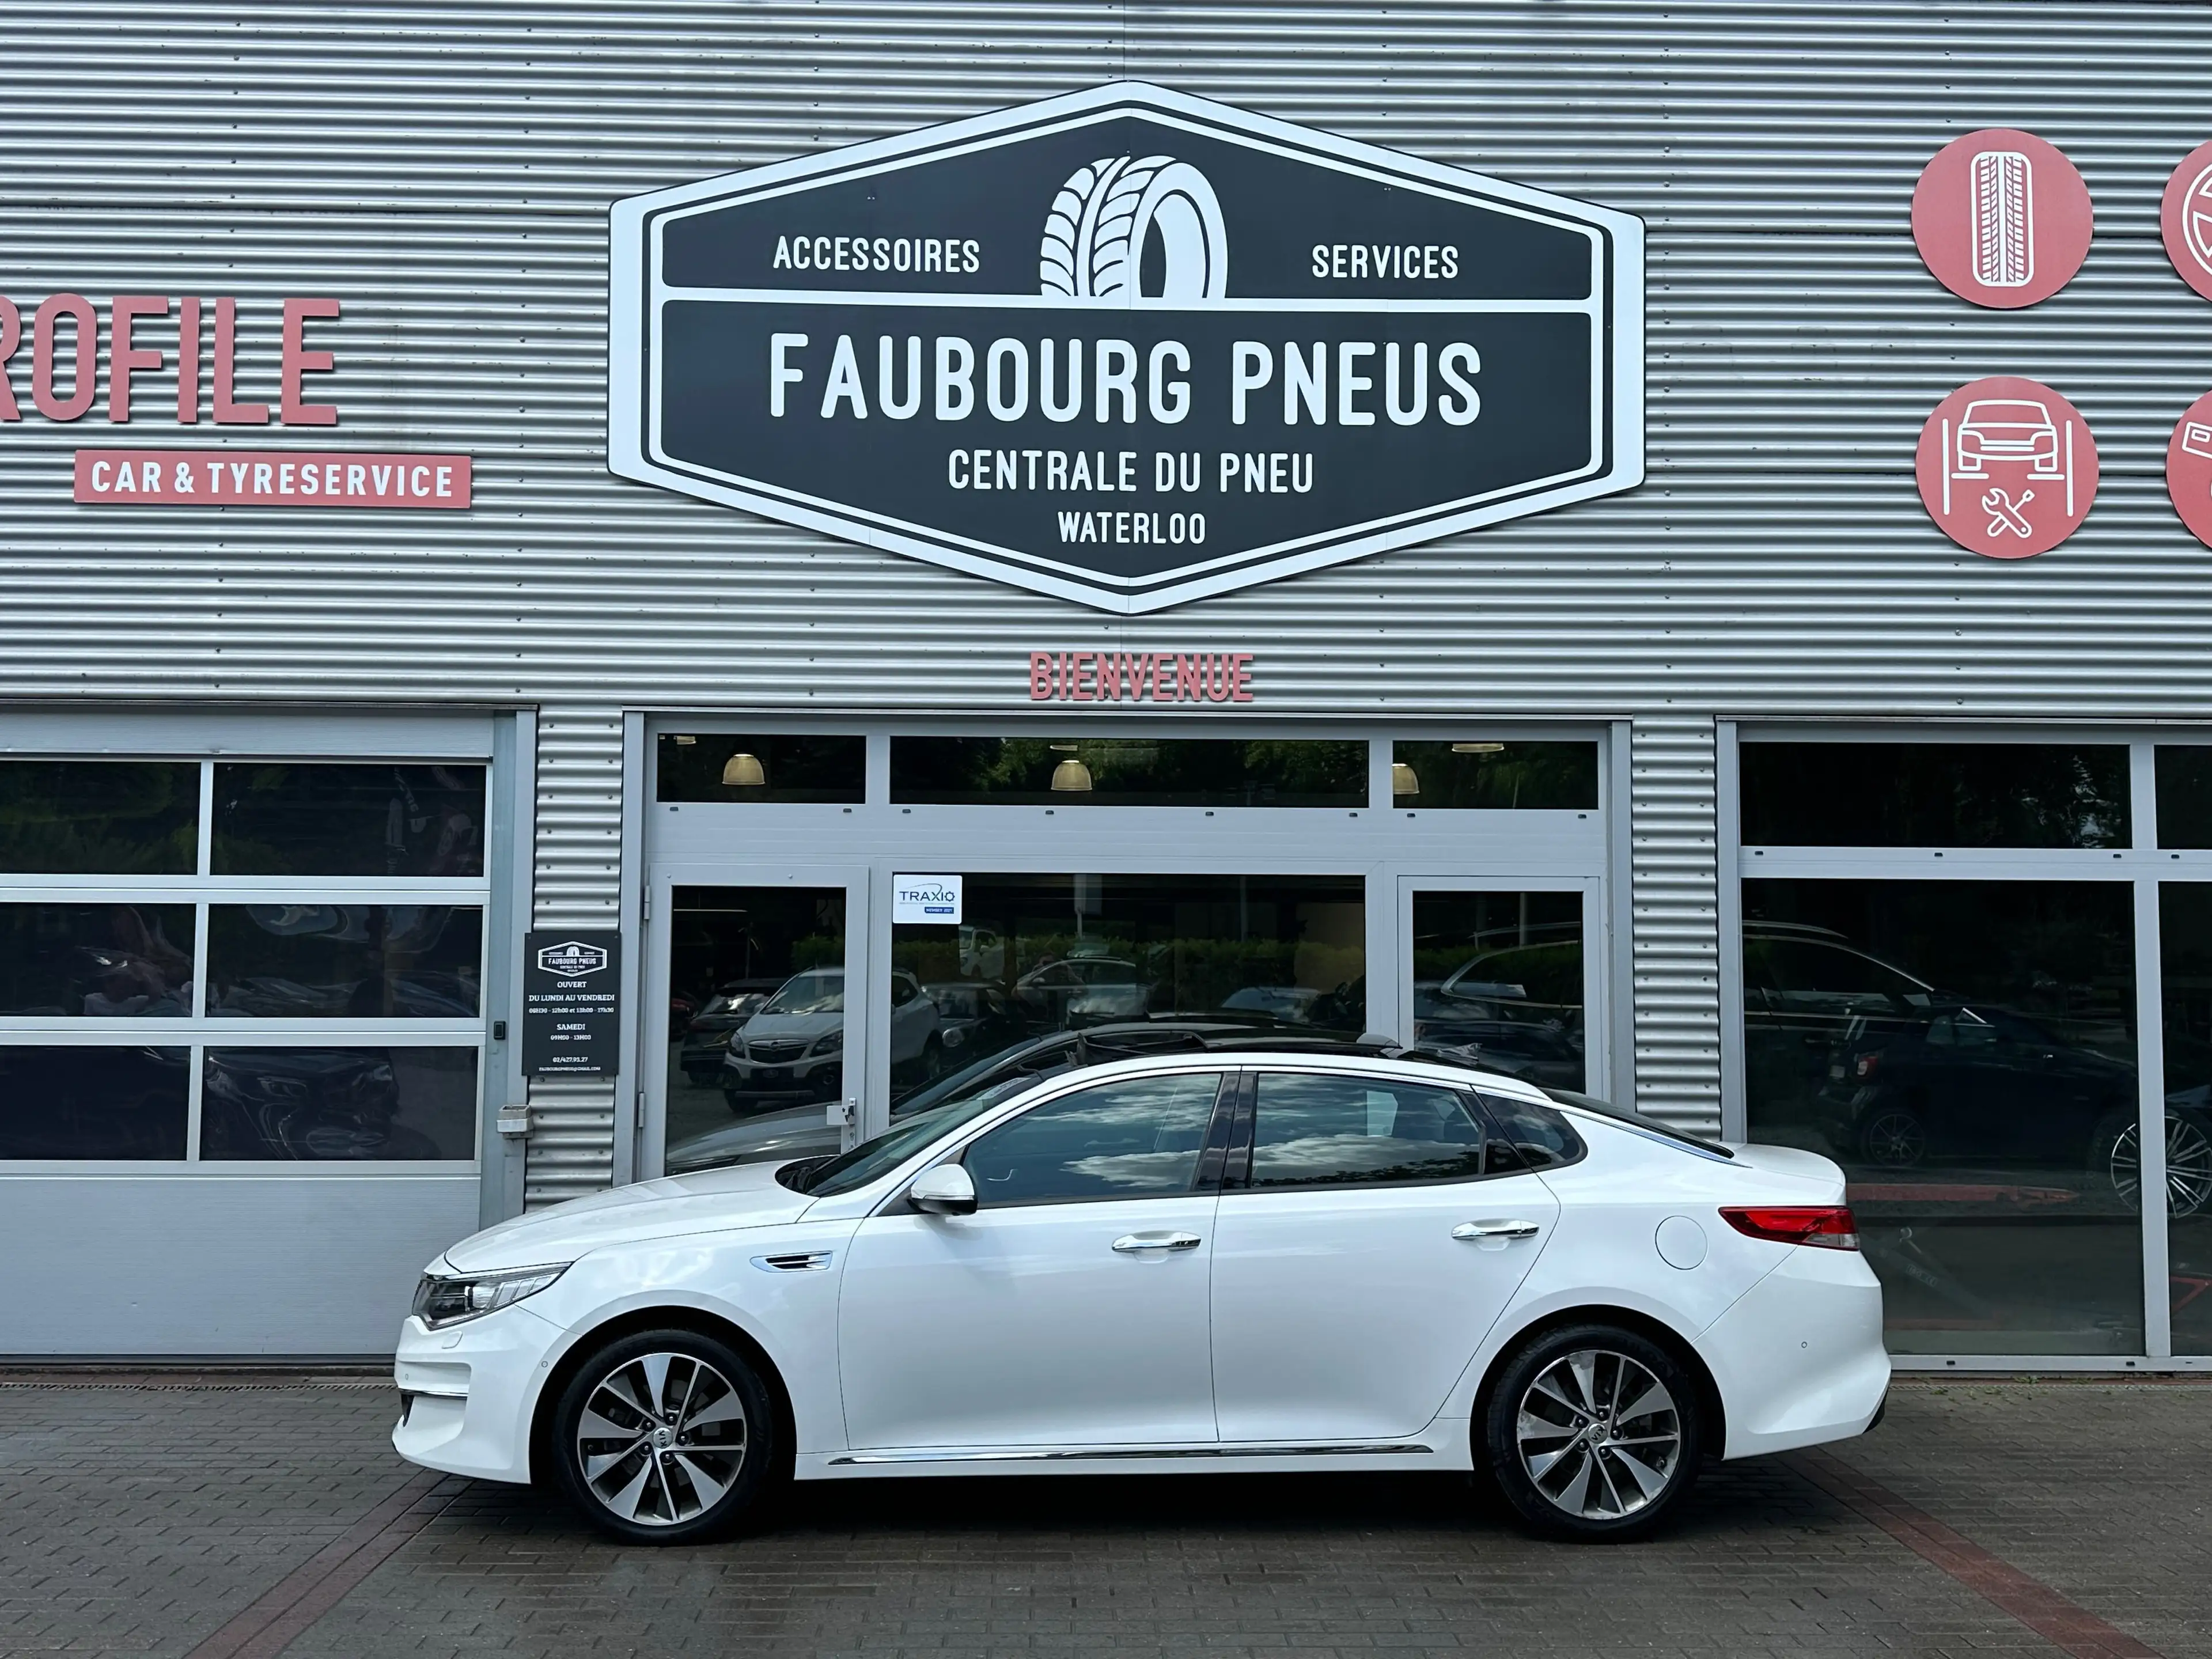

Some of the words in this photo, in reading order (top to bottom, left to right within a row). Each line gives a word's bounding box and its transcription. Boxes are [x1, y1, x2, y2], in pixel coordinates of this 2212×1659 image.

[773, 236, 979, 273] ACCESSOIRES
[1312, 245, 1459, 279] SERVICES
[770, 332, 1191, 425] FAUBOURG
[1232, 341, 1481, 426] PNEUS
[92, 461, 161, 493] CAR
[174, 462, 195, 493] &
[207, 463, 452, 497] TYRESERVICE
[948, 449, 1137, 491] CENTRALE
[1156, 452, 1201, 492] DU
[1220, 453, 1313, 493] PNEU
[1058, 511, 1206, 545] WATERLOO
[1031, 652, 1253, 701] BIENVENUE
[899, 891, 955, 902] TRAXIO
[659, 1430, 667, 1447] KIA
[1591, 1426, 1605, 1440] KIA
